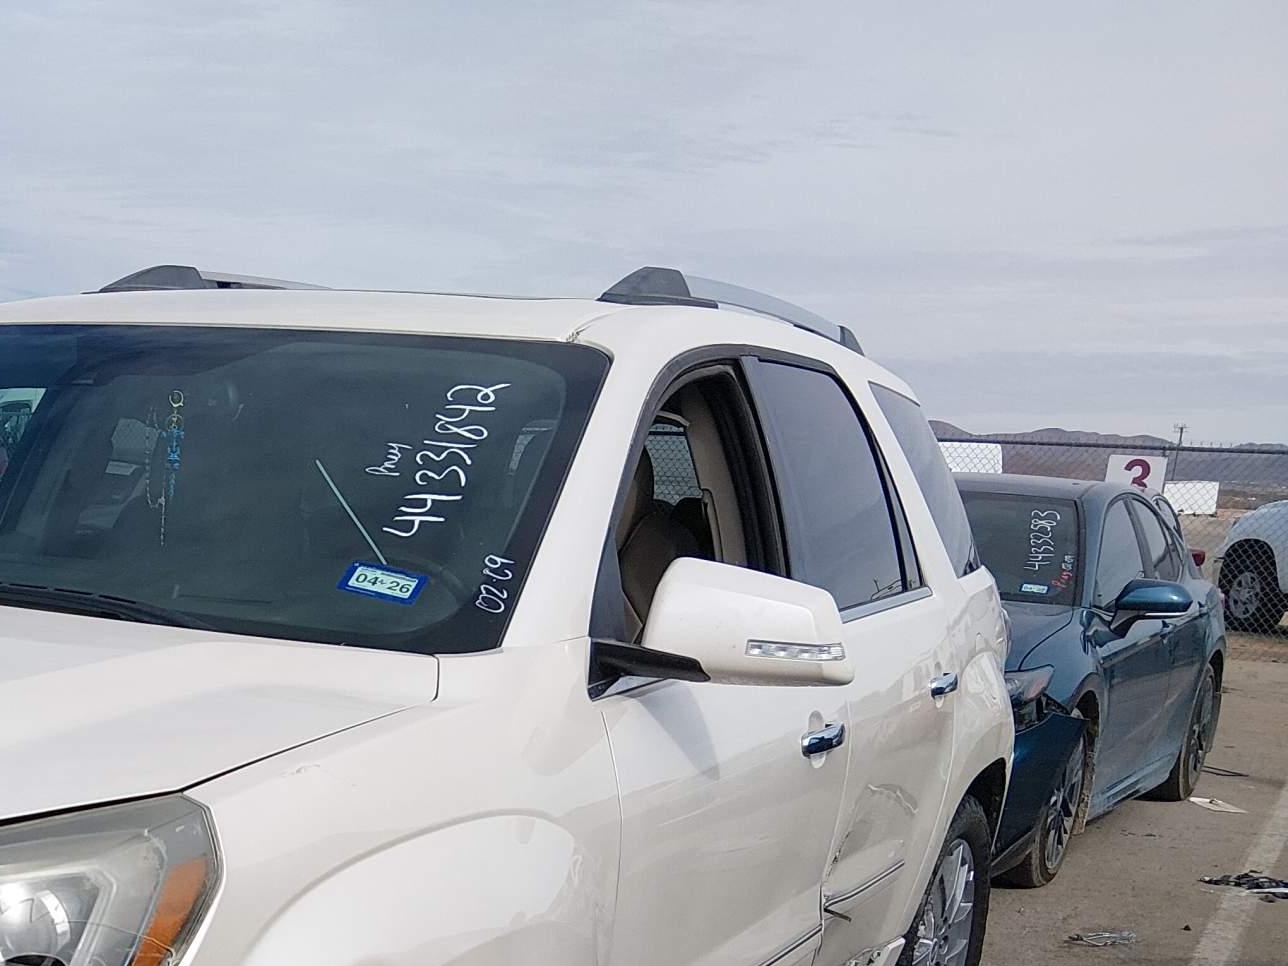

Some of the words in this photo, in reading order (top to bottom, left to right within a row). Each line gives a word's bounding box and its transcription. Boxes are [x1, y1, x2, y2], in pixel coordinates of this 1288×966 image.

[382, 384, 511, 537] 44331842
[1124, 459, 1151, 488] 3
[1023, 510, 1061, 571] 44332583
[387, 580, 412, 594] 26
